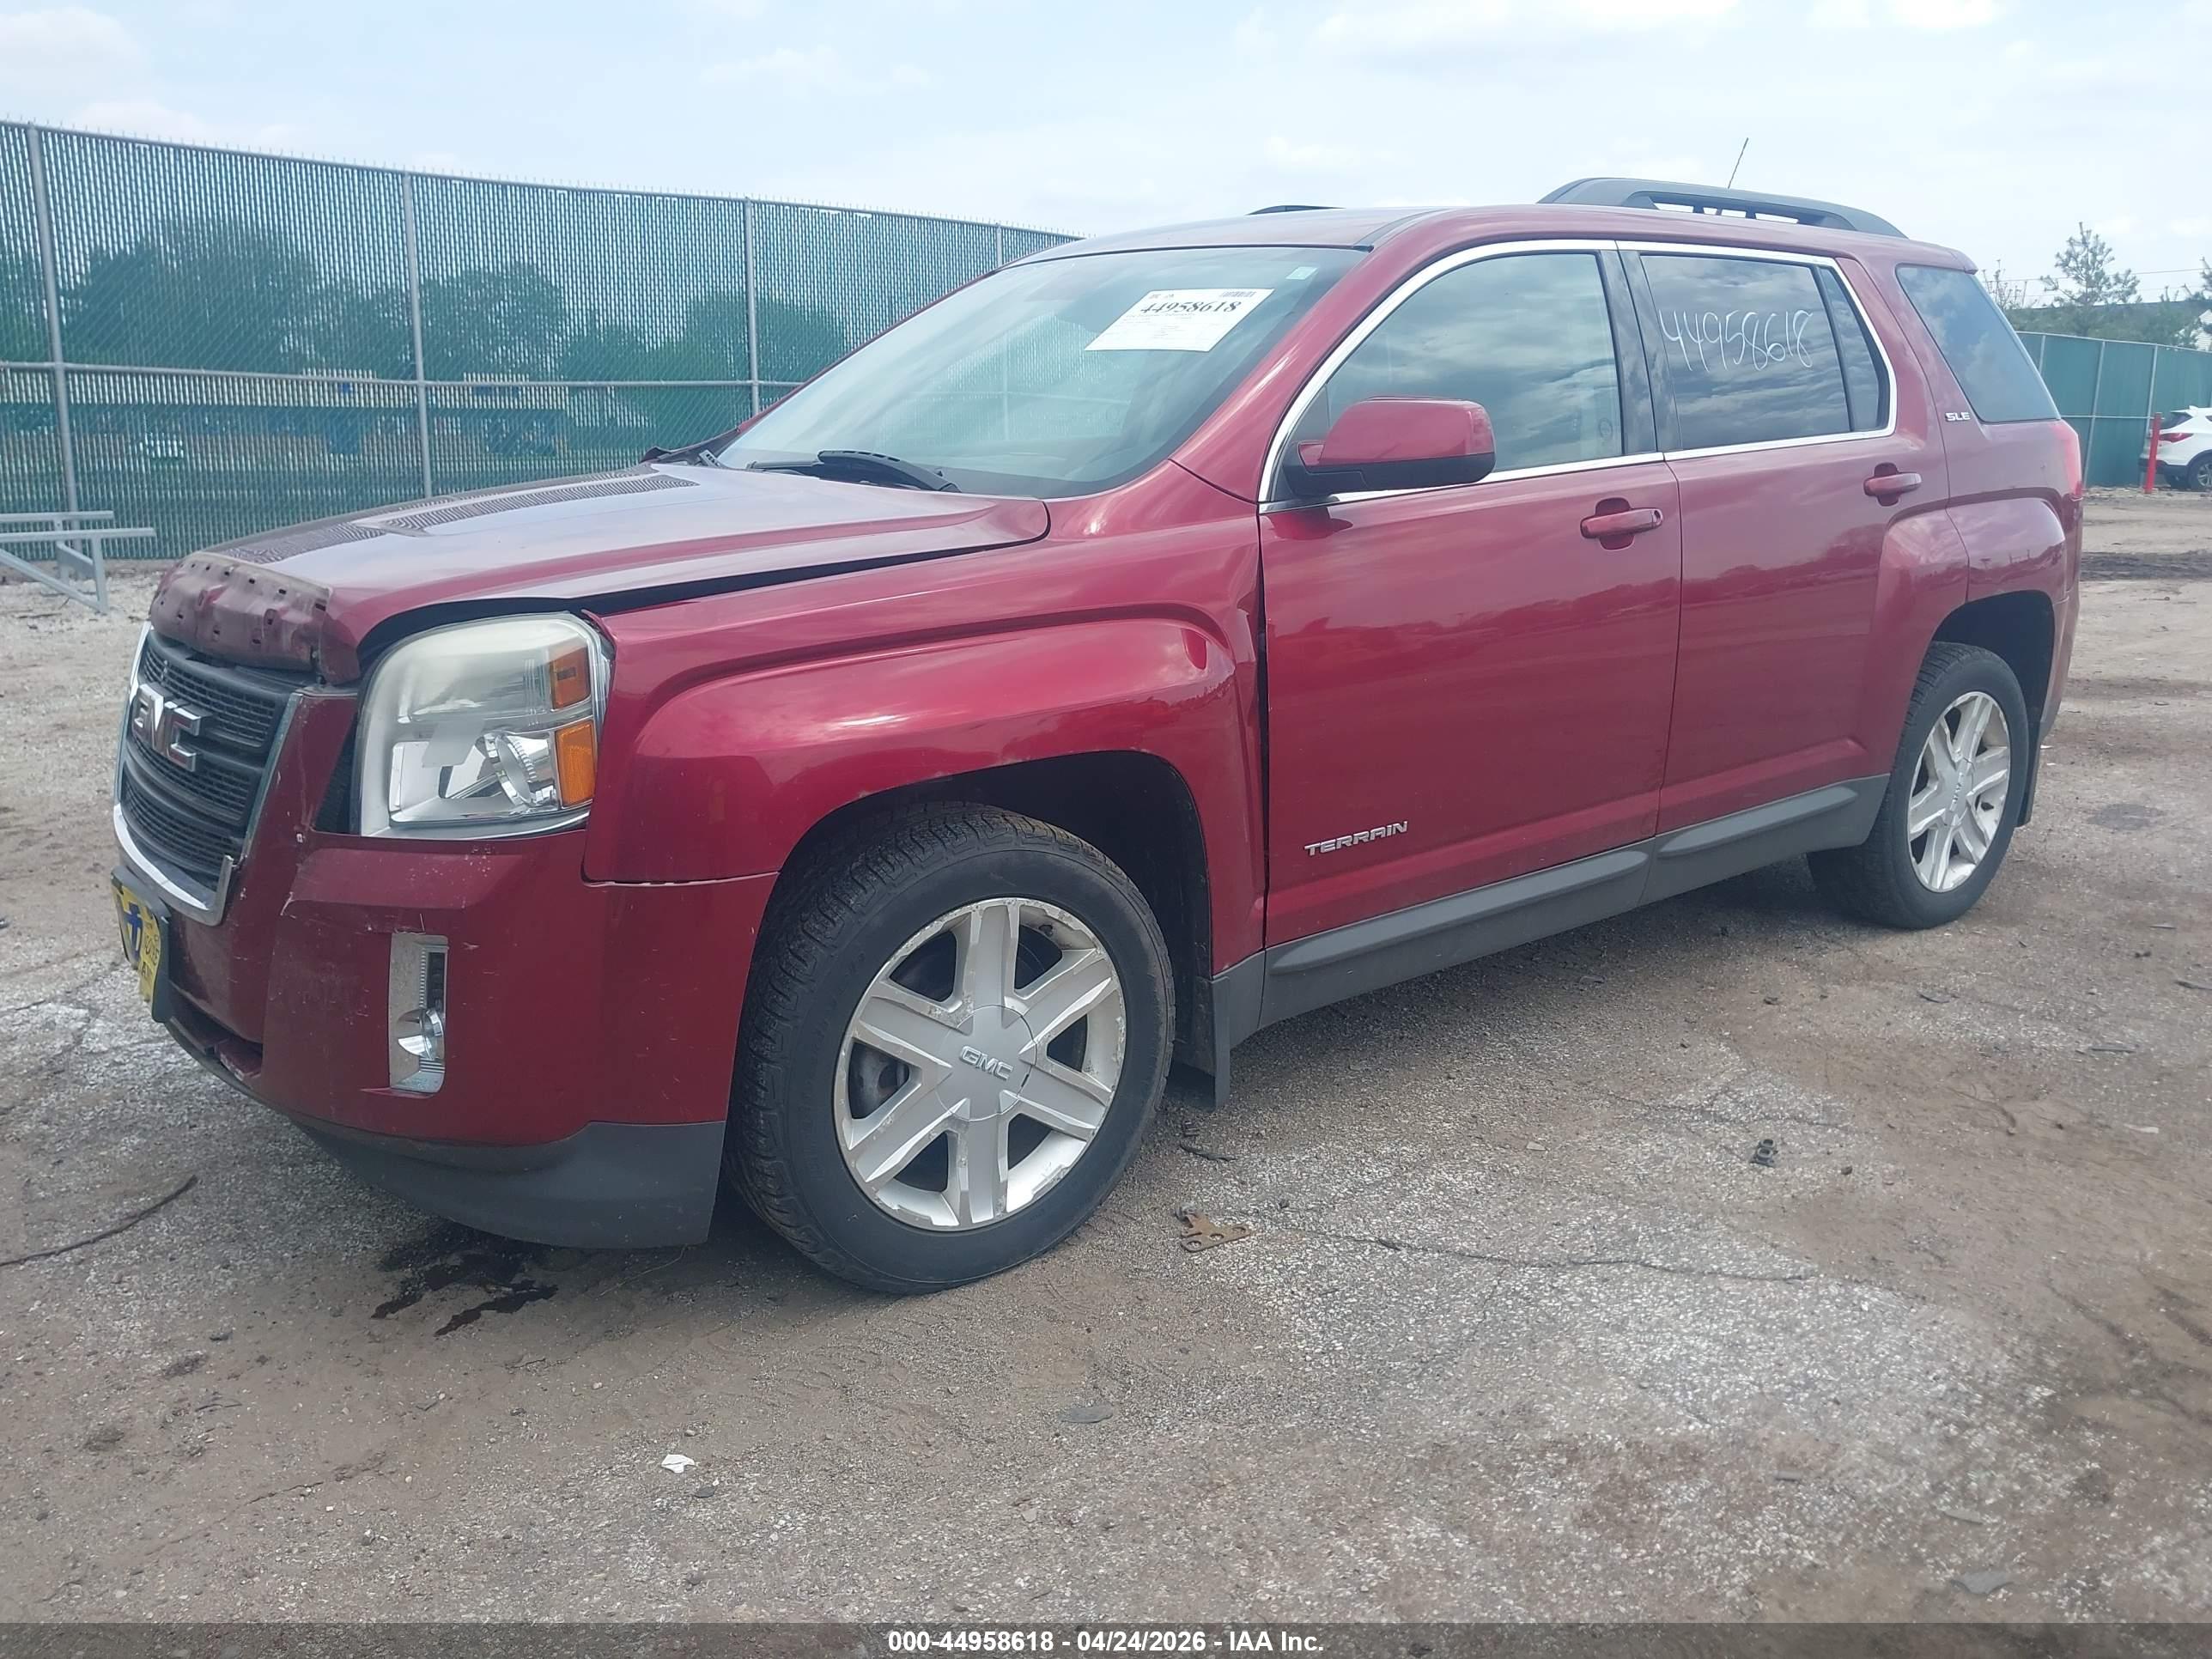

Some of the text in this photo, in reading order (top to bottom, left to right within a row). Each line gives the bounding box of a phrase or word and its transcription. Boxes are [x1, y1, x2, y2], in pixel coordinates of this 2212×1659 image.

[1140, 301, 1243, 313] 44958618
[1657, 308, 1814, 372] 44958618
[1945, 411, 1971, 422] SLE
[1304, 821, 1408, 856] TERRAIN
[960, 1046, 1014, 1081] GMC
